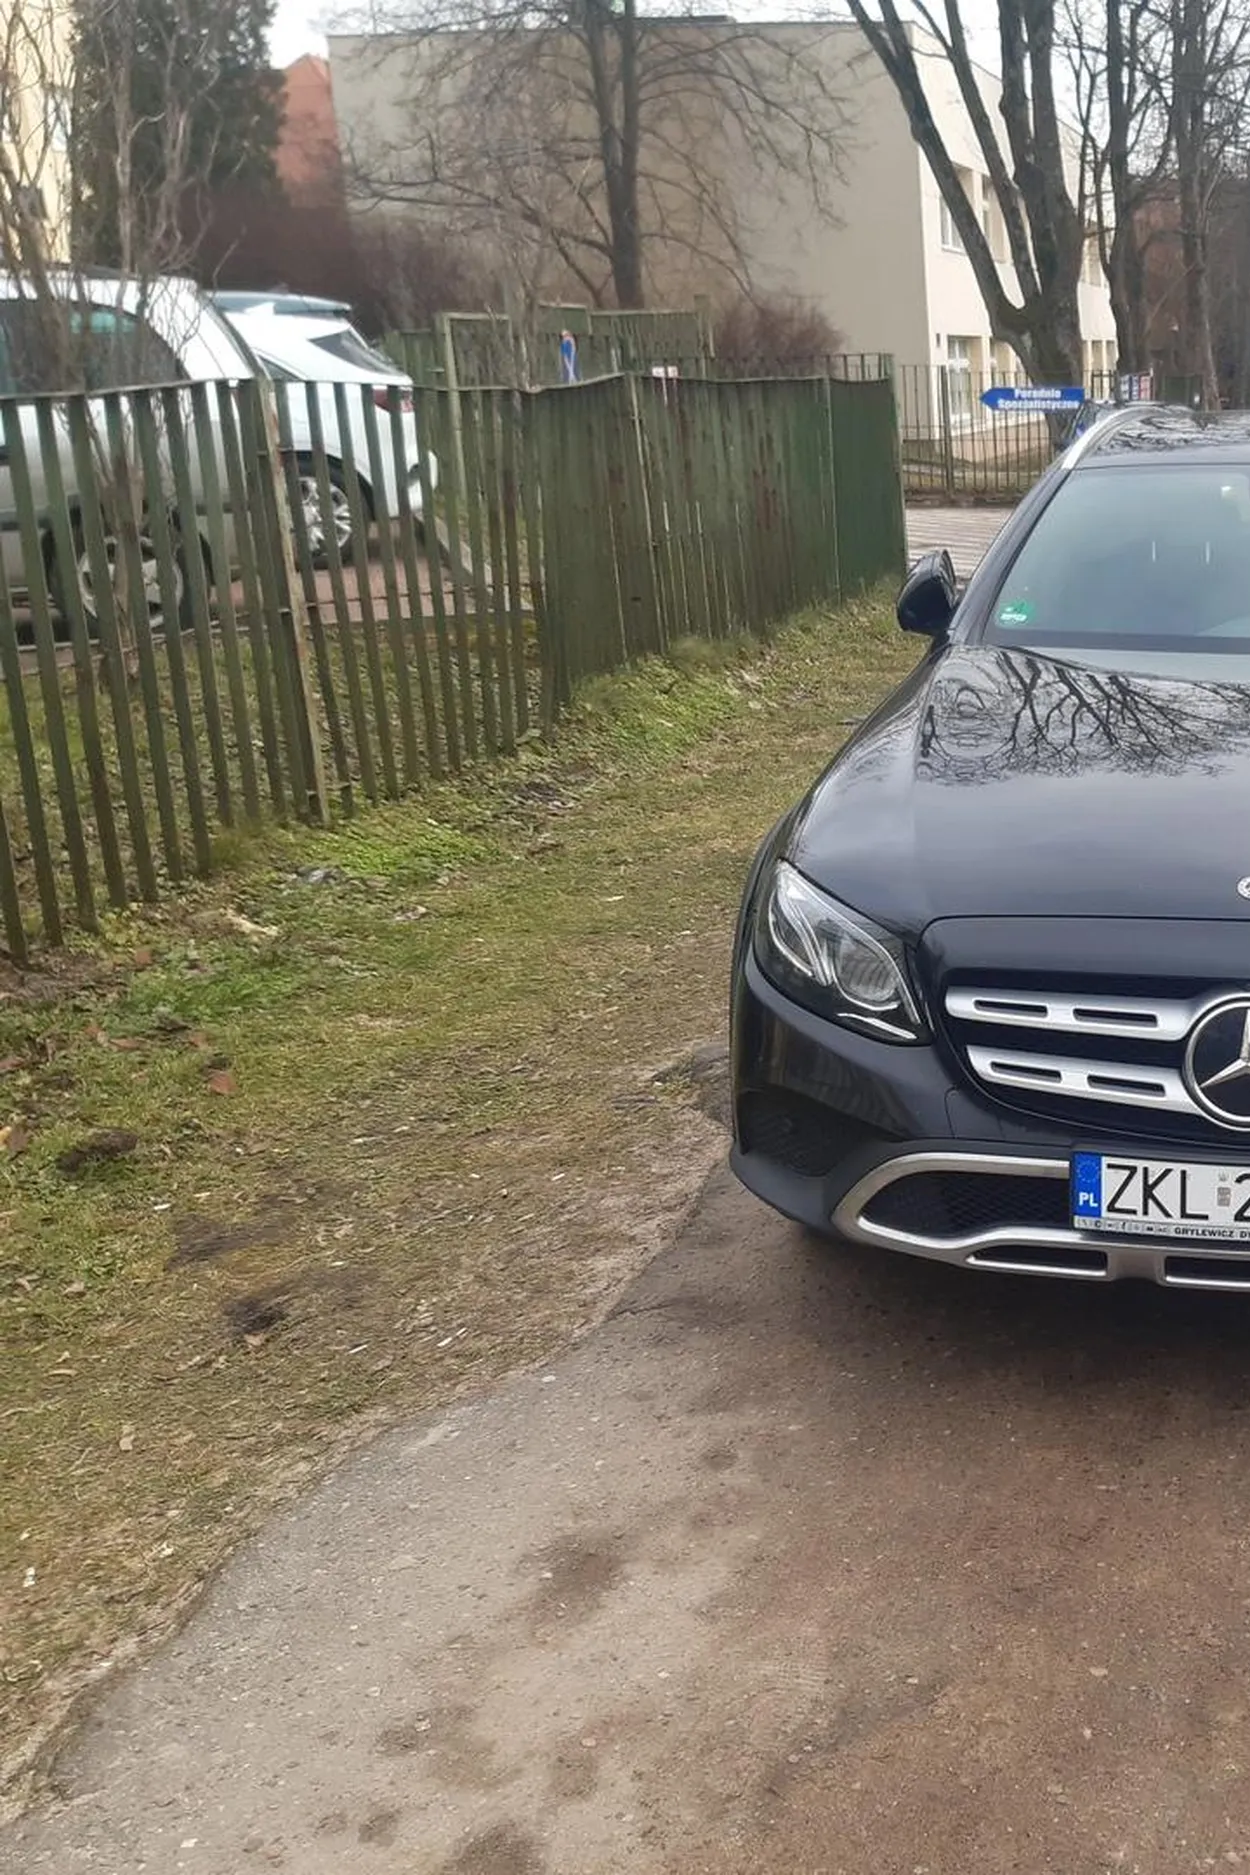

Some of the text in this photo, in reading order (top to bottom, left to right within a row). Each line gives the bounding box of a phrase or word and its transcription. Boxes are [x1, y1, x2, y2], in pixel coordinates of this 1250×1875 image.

[1078, 1192, 1099, 1208] PL
[1106, 1163, 1209, 1221] ZKL
[1174, 1226, 1235, 1239] GRYLEWICZ
